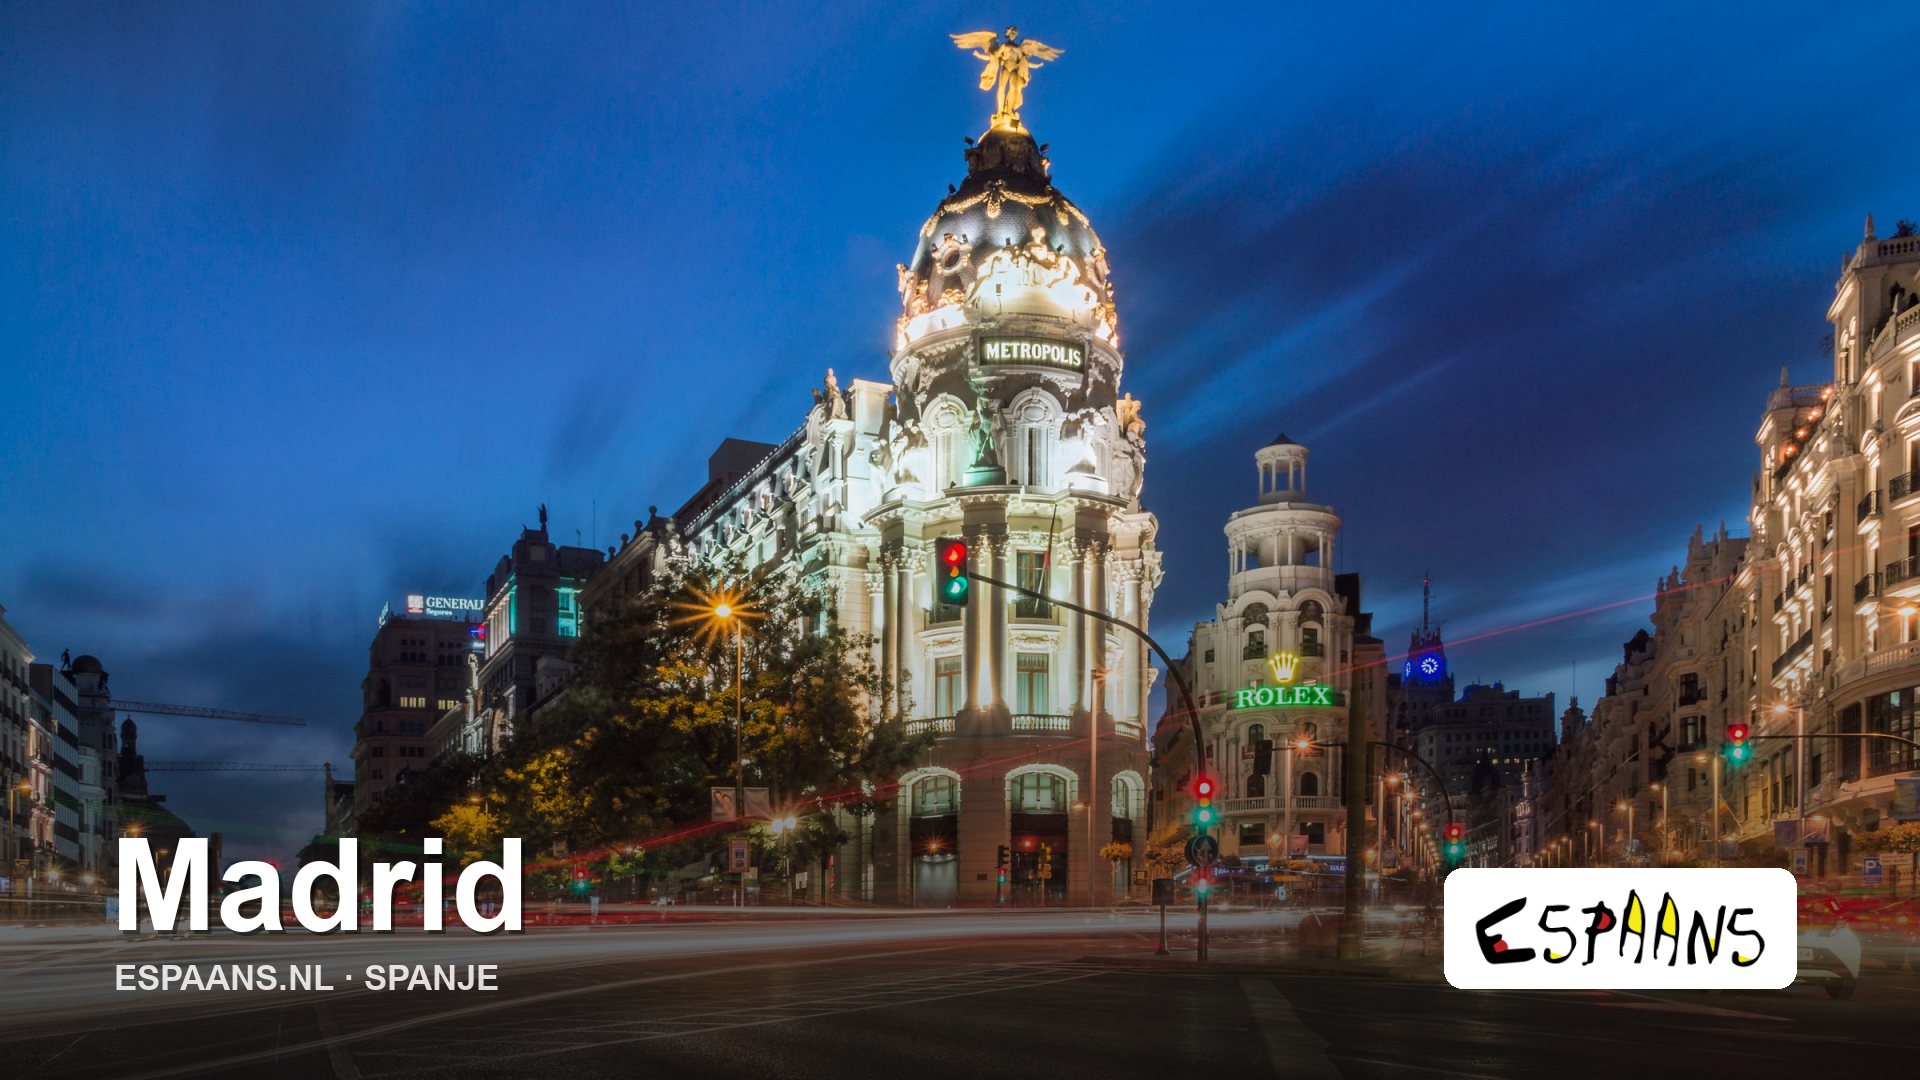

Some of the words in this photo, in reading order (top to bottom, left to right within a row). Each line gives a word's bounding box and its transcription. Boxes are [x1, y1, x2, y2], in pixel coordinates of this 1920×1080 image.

[986, 342, 1081, 366] METROPOLIS
[426, 596, 485, 611] GENERALI
[426, 608, 453, 616] Seguros
[1237, 687, 1331, 708] ROLEX
[1864, 860, 1877, 874] P
